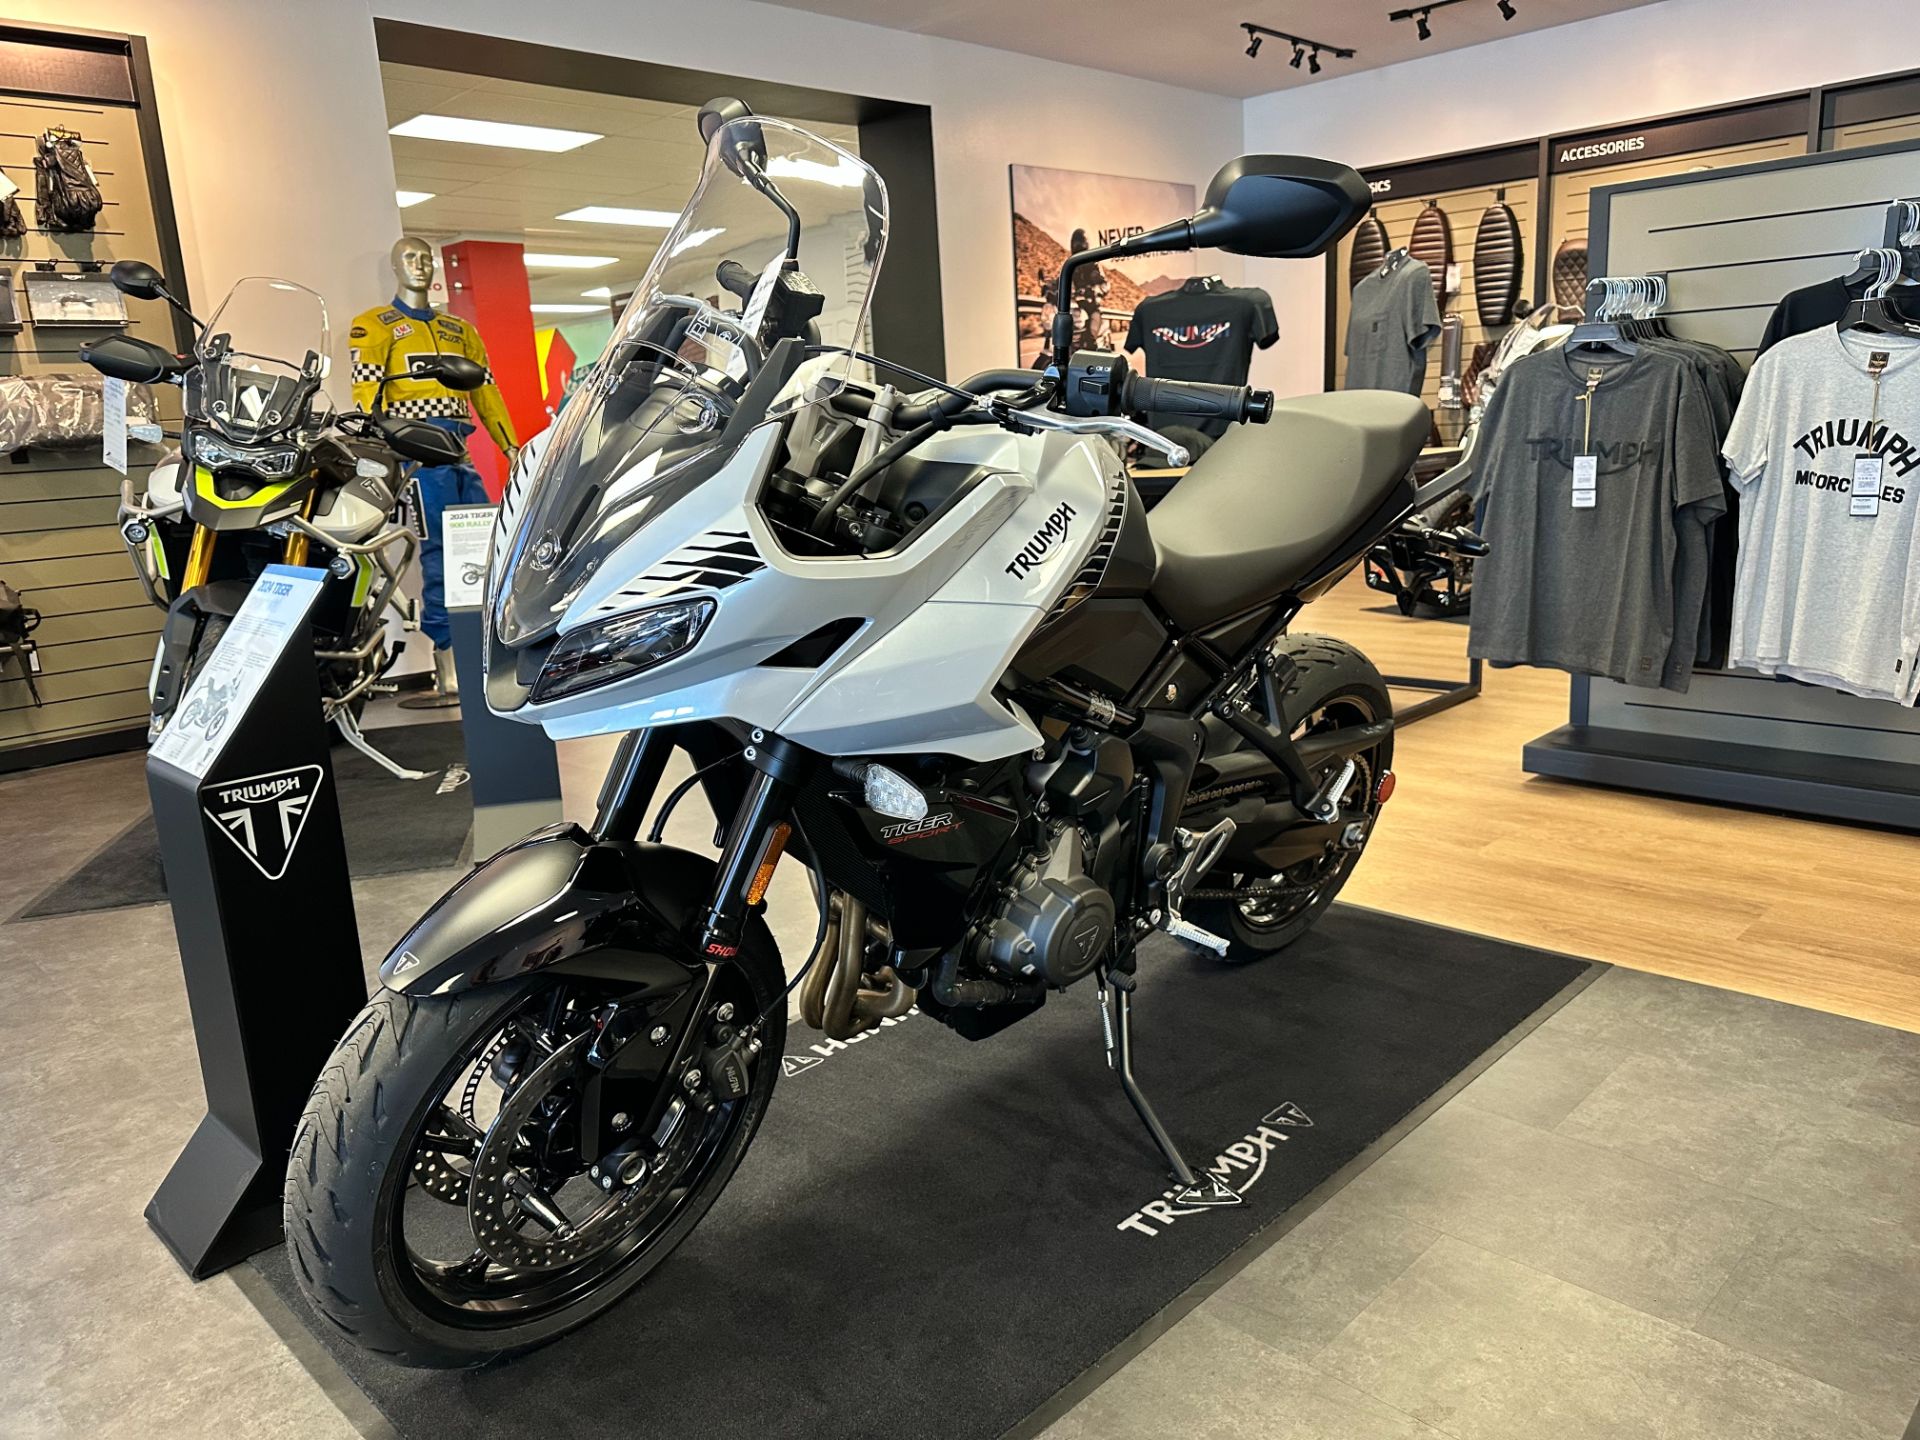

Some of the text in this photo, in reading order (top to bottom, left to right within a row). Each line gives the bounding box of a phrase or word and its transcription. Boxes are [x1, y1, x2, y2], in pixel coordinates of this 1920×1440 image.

[1560, 136, 1645, 163] ACCESSORIES
[1152, 321, 1232, 348] TRIUMPH
[1793, 418, 1920, 478] TRIUMPH
[466, 520, 492, 528] RALLY
[470, 511, 494, 519] TIGER
[1005, 501, 1077, 581] TRIUMPH
[219, 776, 300, 804] TRIUMPH
[880, 812, 953, 838] TIGER
[887, 821, 966, 845] SPORT
[1116, 1125, 1291, 1237] TRMPH
